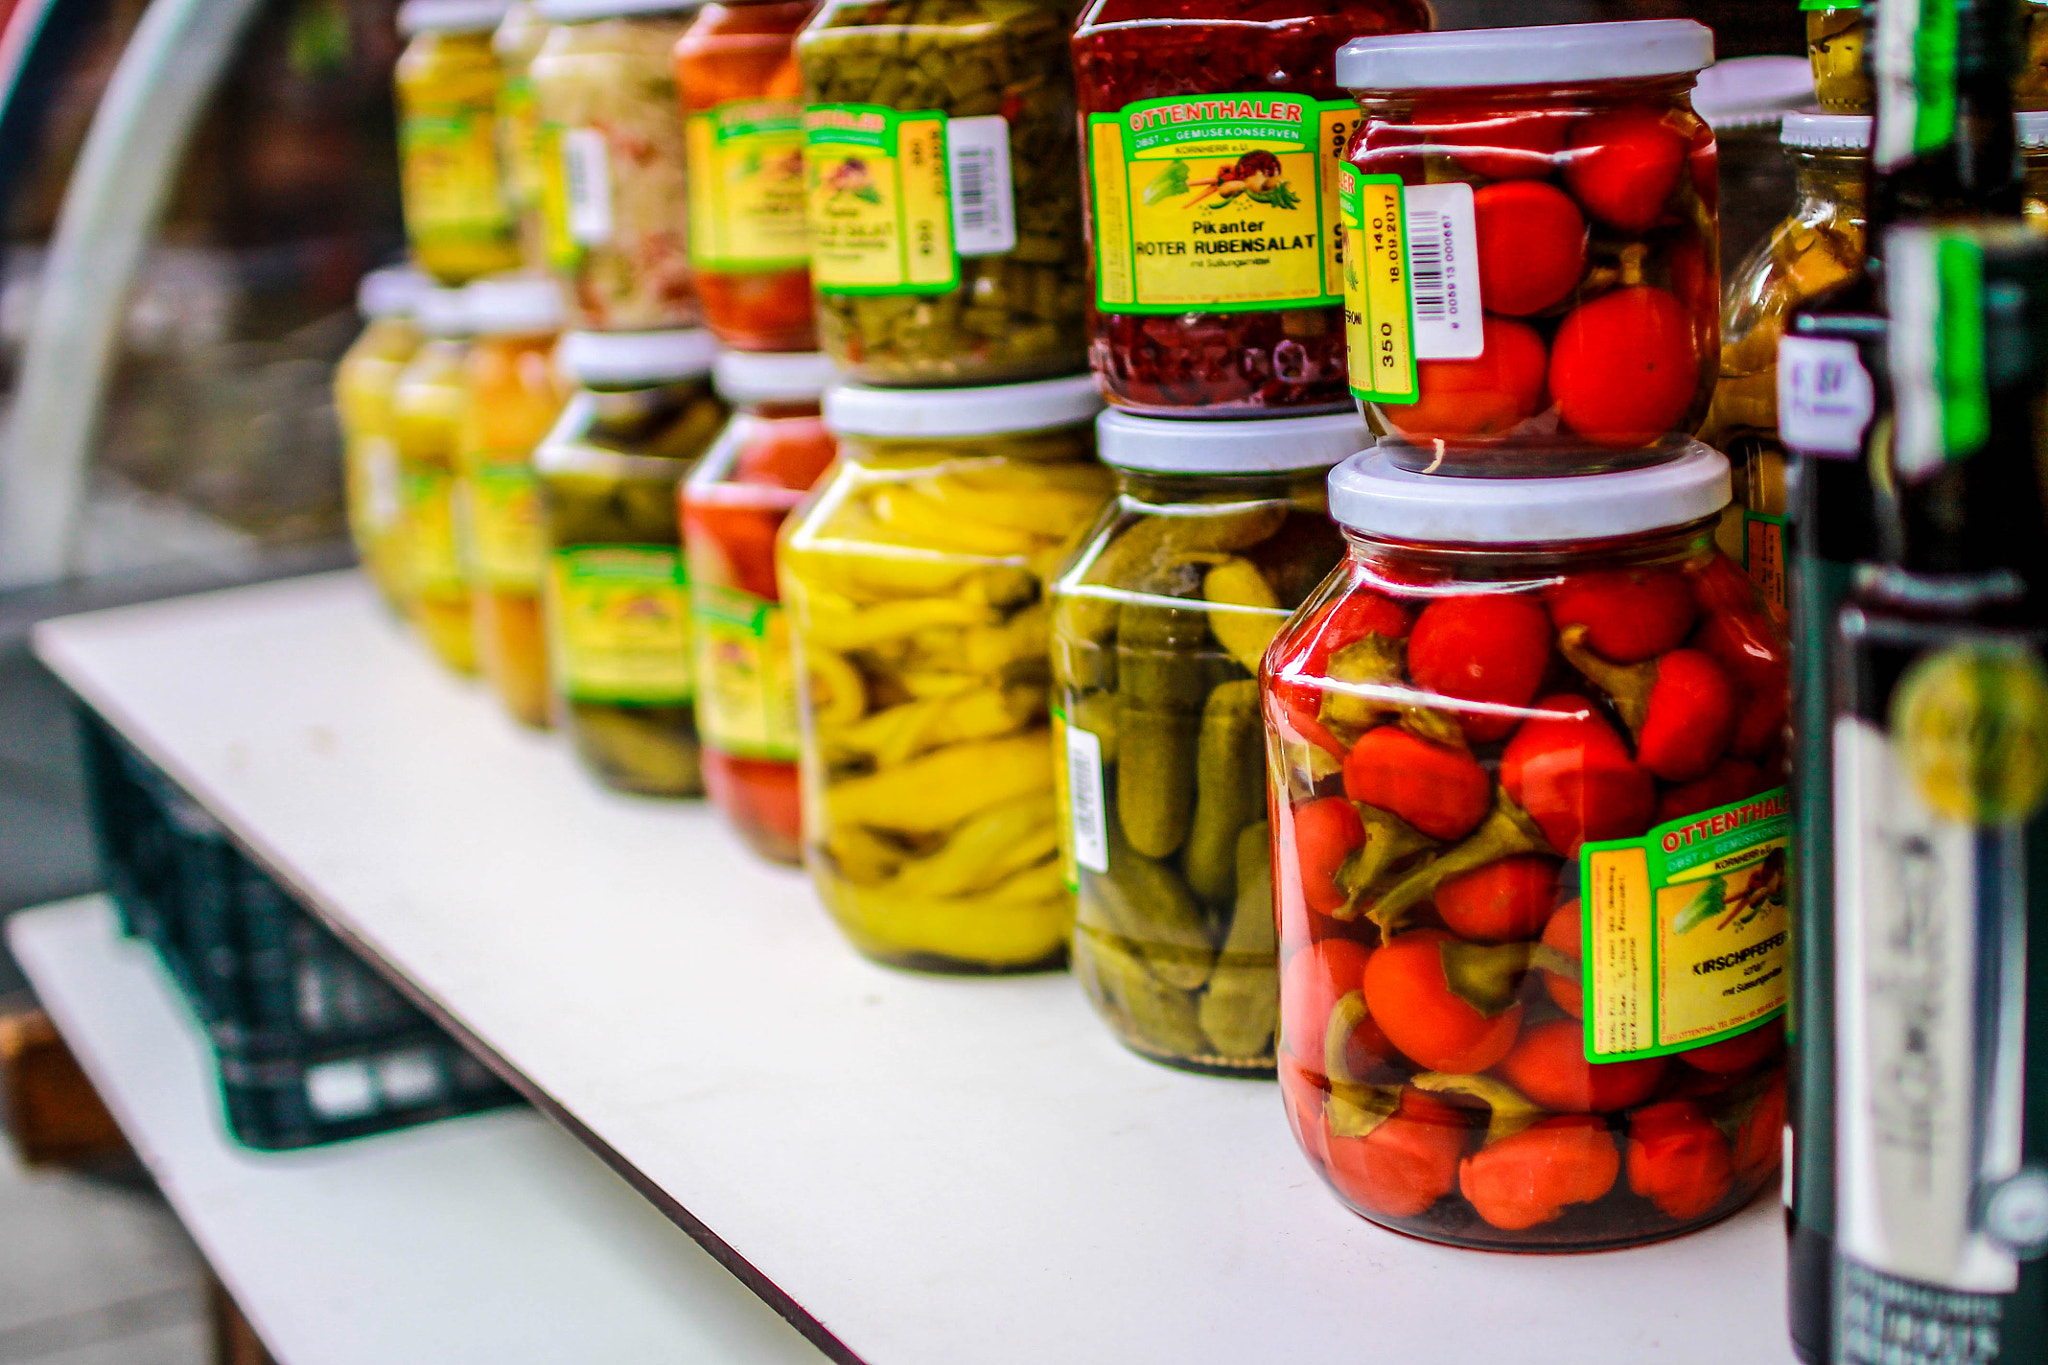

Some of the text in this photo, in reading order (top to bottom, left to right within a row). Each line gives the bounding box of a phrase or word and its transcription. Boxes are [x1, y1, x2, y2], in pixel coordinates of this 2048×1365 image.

[1129, 100, 1303, 132] OTTENTHALER
[1135, 134, 1160, 149] OBST
[1176, 125, 1299, 141] GEMÜSEKONSERVEN
[1193, 219, 1265, 235] Pikanter
[1373, 218, 1384, 252] 140
[1385, 194, 1400, 283] 18.09.2017
[1136, 241, 1185, 256] ROTER
[1380, 322, 1395, 368] 350
